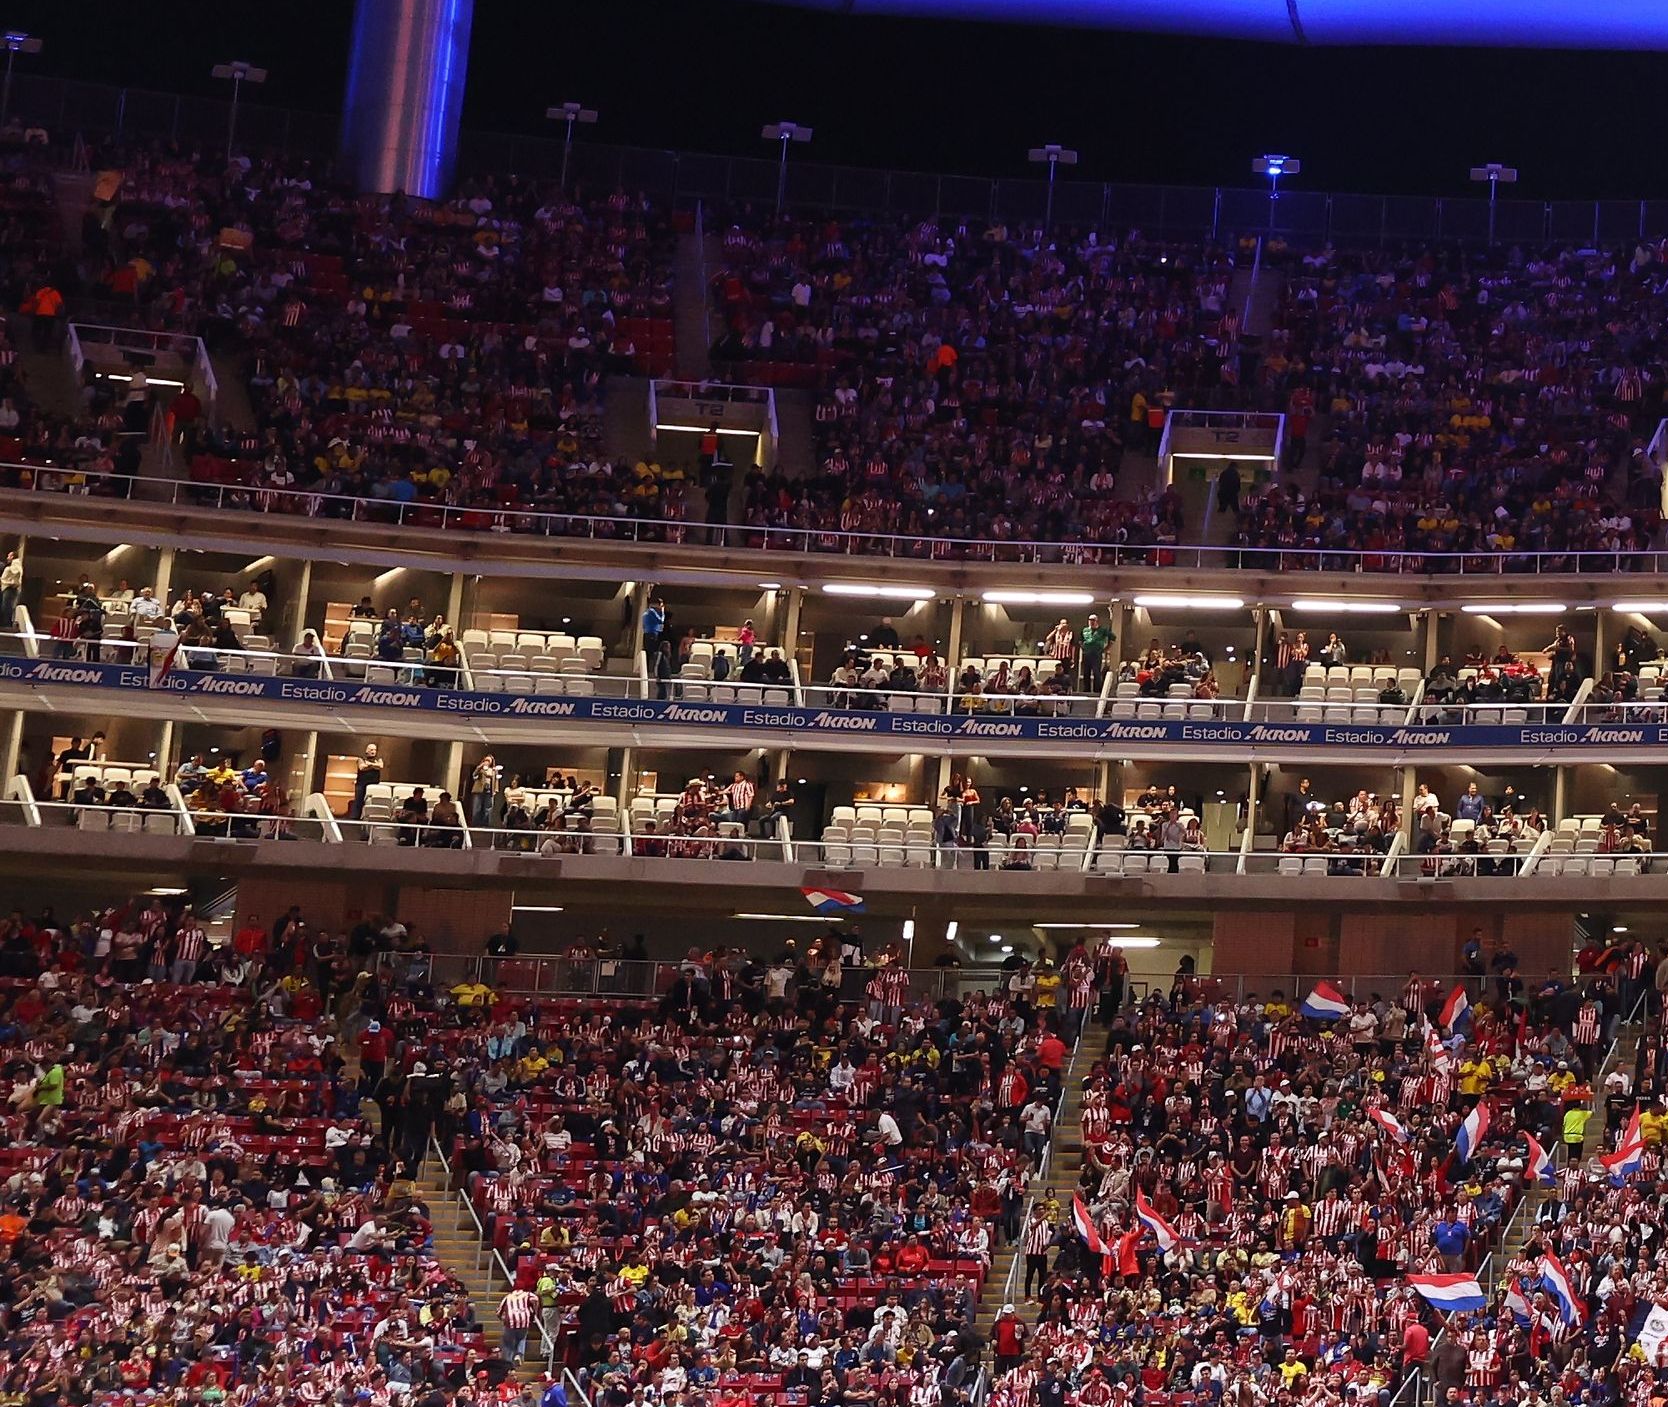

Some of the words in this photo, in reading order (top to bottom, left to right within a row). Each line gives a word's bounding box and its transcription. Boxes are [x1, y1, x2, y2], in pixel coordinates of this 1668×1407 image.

[696, 403, 724, 416] T2
[1212, 431, 1240, 443] T2
[25, 663, 103, 684] AKRON
[119, 671, 187, 690] Estdio
[191, 676, 264, 695] AKRON
[281, 683, 346, 703] Estadio
[349, 687, 419, 706] AKRON
[436, 694, 500, 712] Estadio
[503, 697, 574, 716] AKRON
[591, 703, 654, 719] Estadio
[658, 704, 727, 723] AKRON
[744, 711, 806, 726] Estadio
[808, 712, 876, 730] AKRON
[892, 717, 952, 733] Estadio
[955, 719, 1023, 736] AKRON
[1038, 723, 1098, 739] Estadio
[1100, 723, 1167, 739] AKRON
[1183, 724, 1242, 740] Estadio
[1244, 725, 1310, 741] AKRON
[1325, 728, 1384, 744] Estadio
[1387, 729, 1450, 744] AKRON
[1520, 729, 1577, 744] Estadio
[1580, 727, 1644, 743] AKRON
